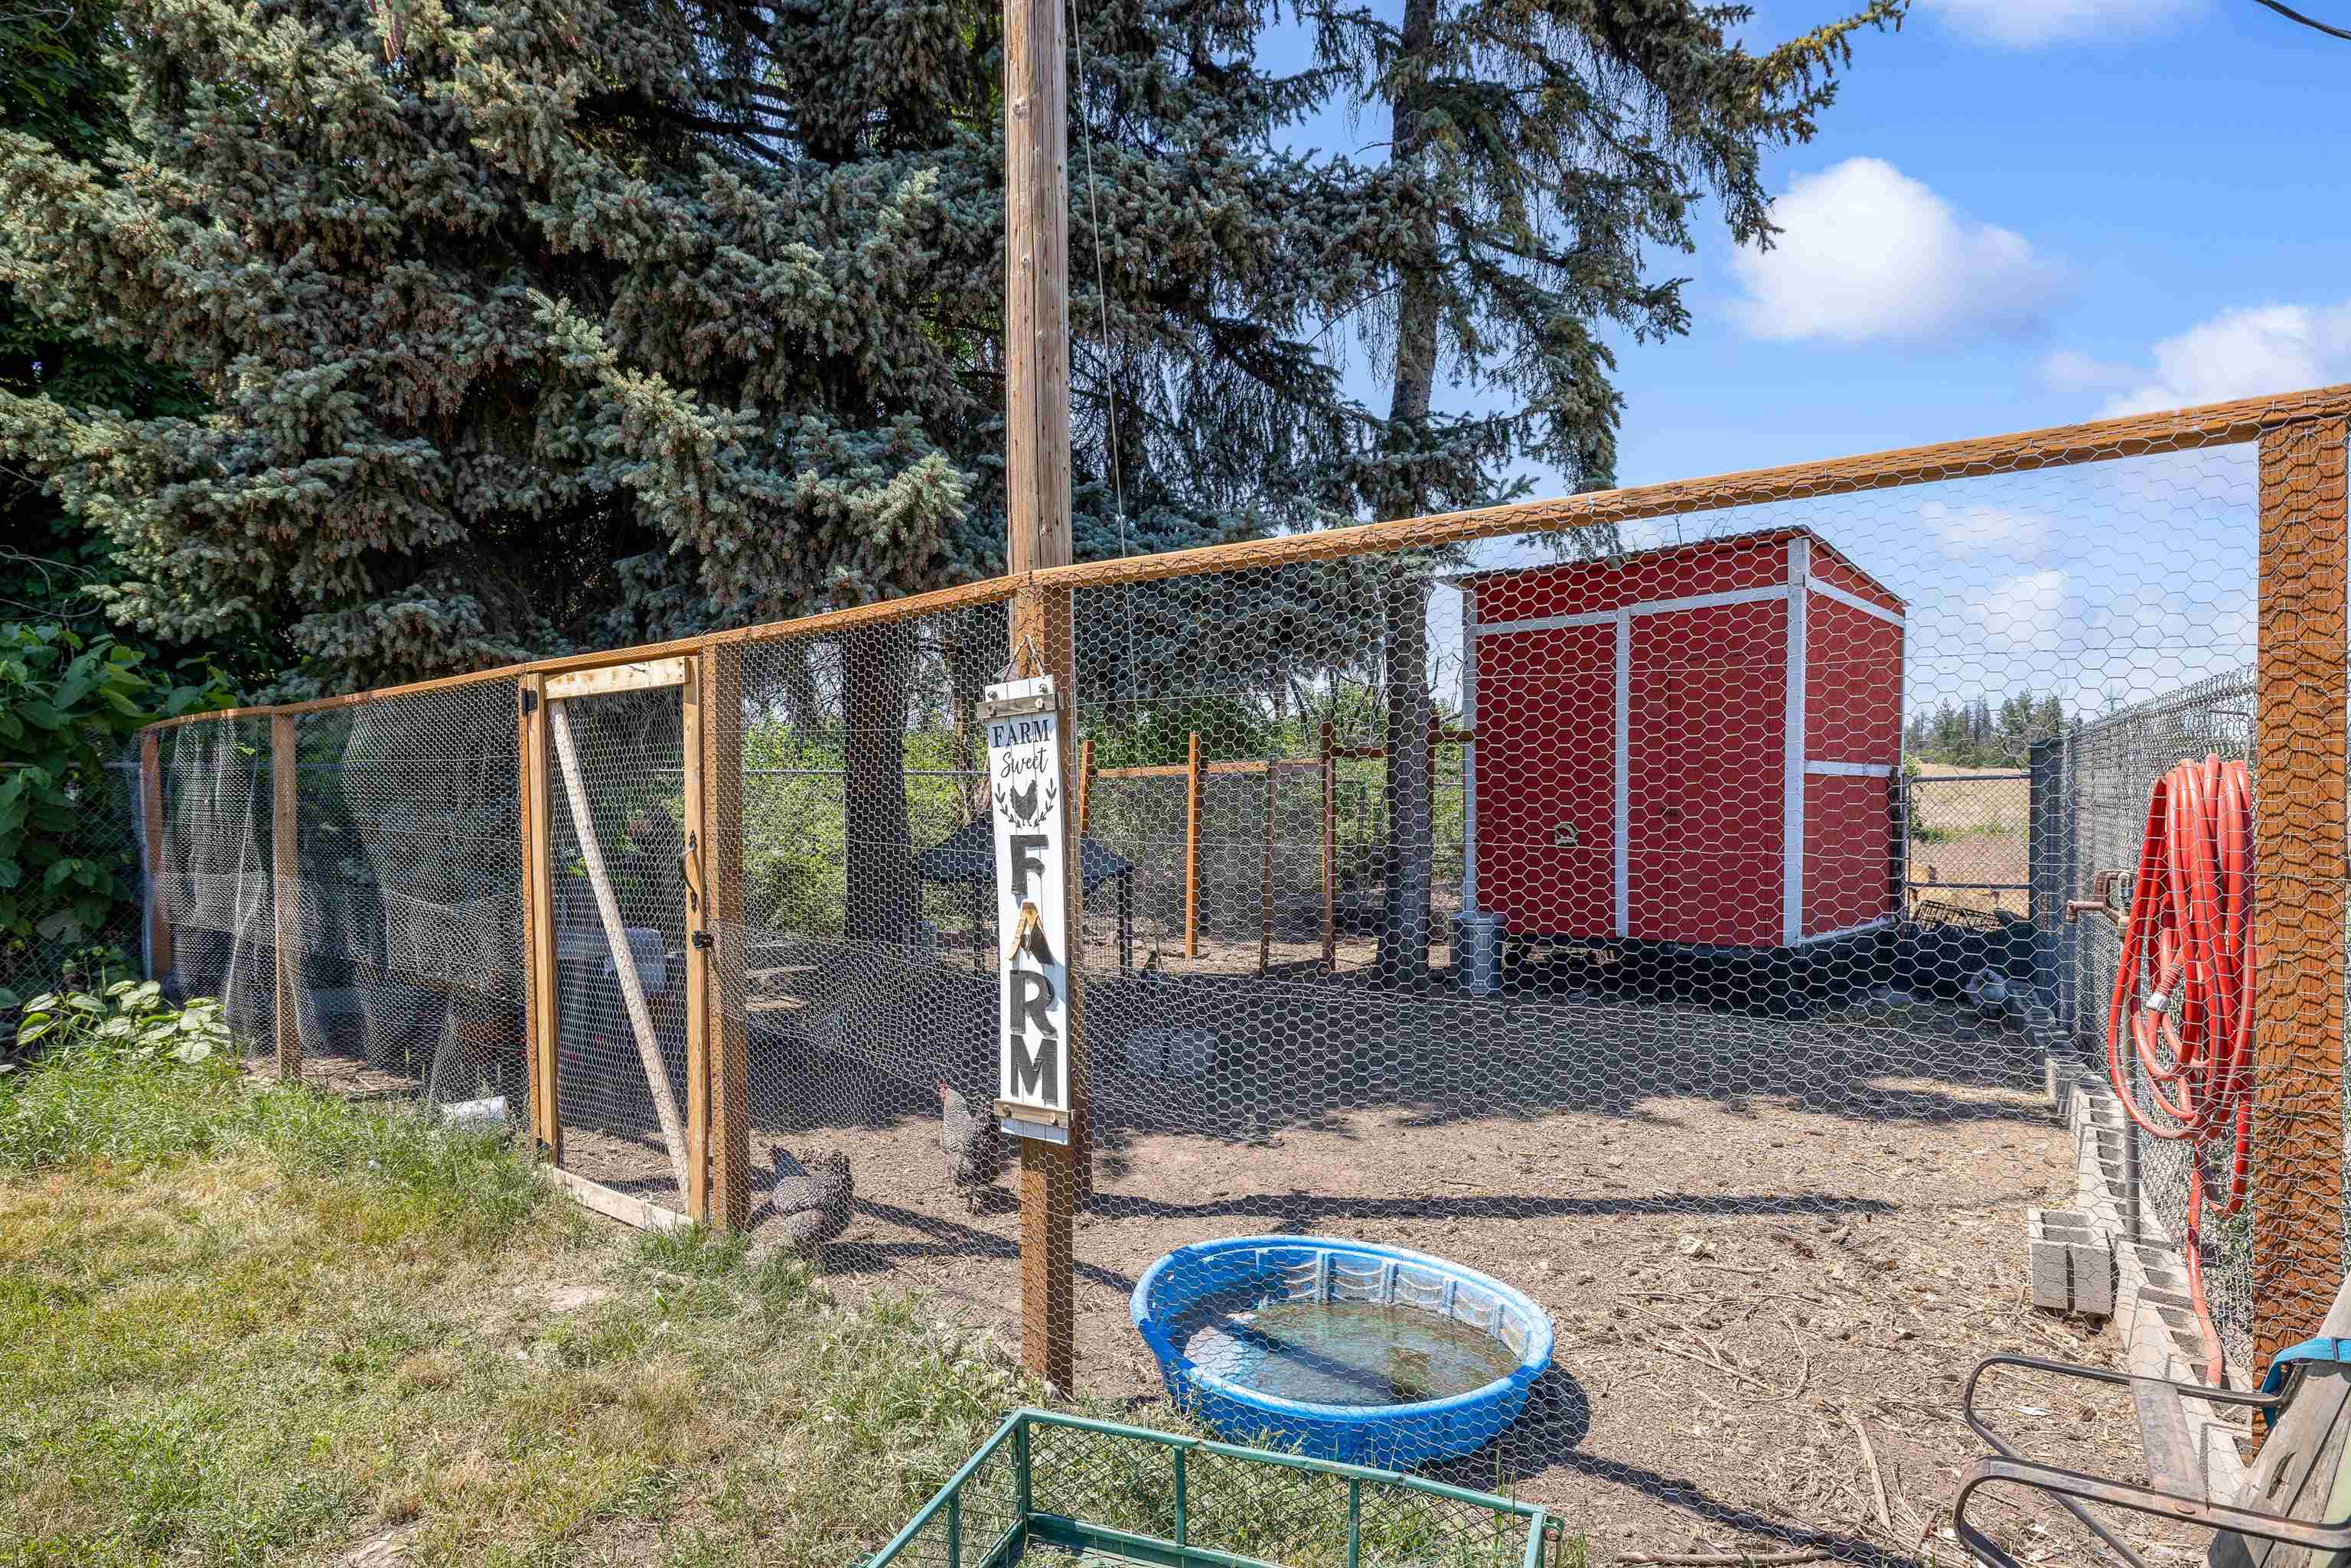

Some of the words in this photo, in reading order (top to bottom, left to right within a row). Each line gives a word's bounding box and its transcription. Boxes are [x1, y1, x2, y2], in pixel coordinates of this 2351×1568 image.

[992, 719, 1050, 748] FARM
[1001, 747, 1048, 777] Sweet
[1006, 835, 1058, 1106] FARM
